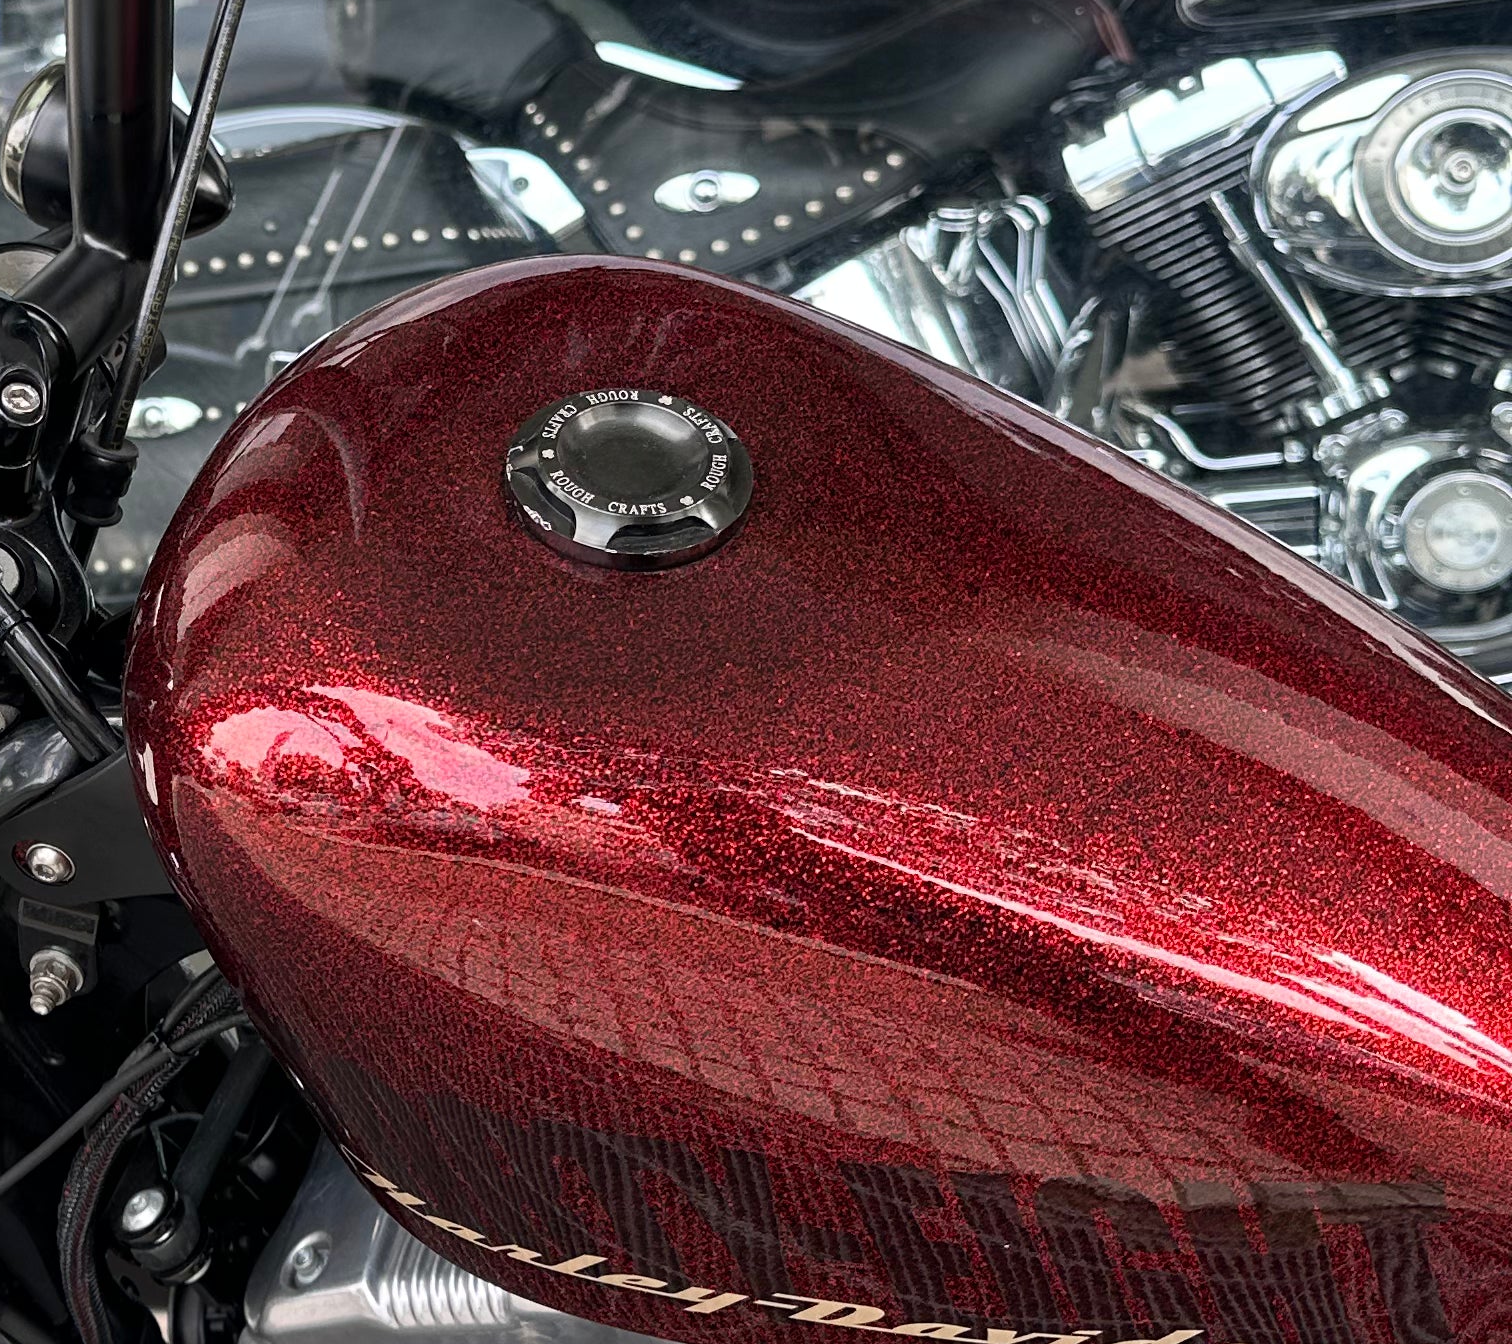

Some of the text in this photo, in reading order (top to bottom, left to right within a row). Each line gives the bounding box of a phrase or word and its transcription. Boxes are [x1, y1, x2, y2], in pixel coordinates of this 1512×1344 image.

[542, 390, 639, 439] ROUGH CRAFTS
[683, 406, 727, 491] ROUGH CRAFTS
[550, 470, 667, 515] ROUGH CRAFTS
